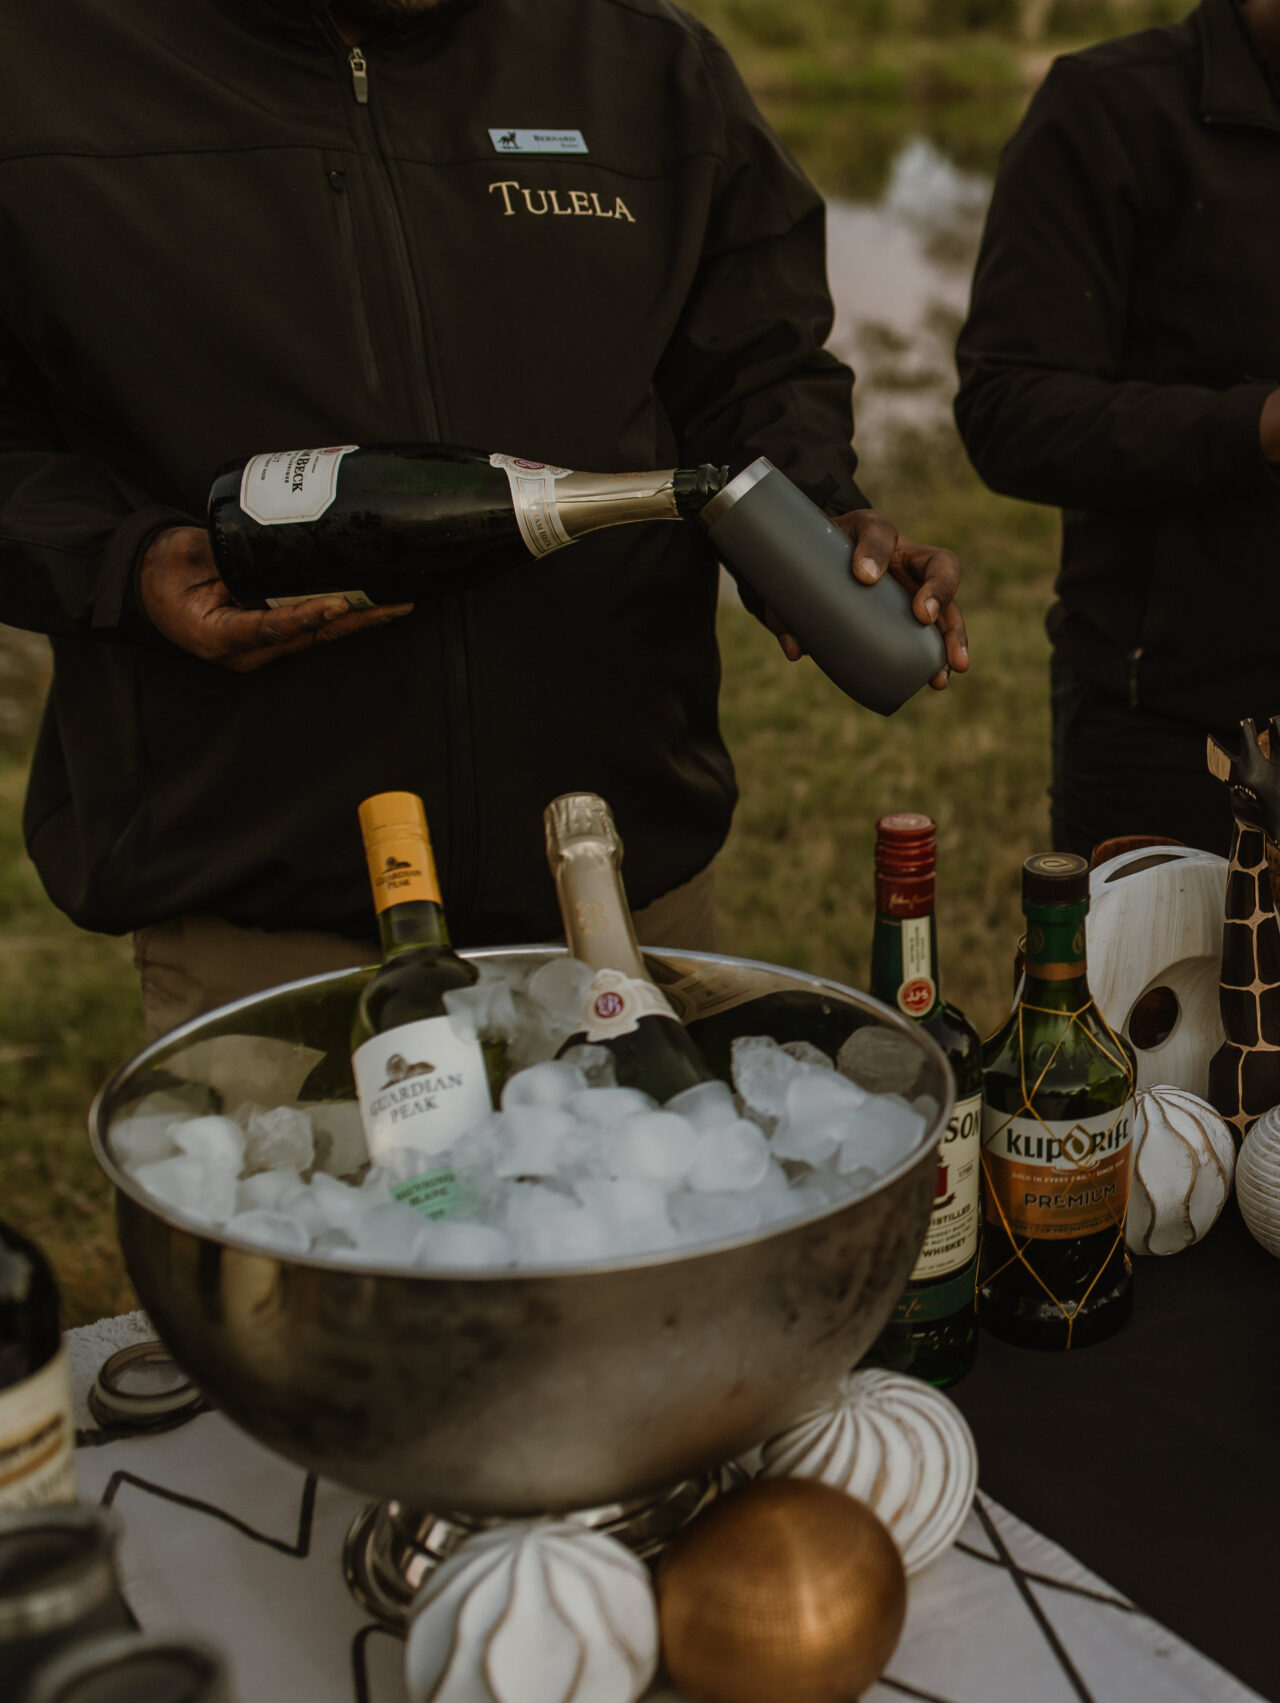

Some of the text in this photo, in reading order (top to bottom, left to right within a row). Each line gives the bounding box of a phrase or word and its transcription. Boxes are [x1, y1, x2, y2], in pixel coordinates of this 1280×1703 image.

[488, 181, 636, 223] TULELA
[370, 1073, 464, 1116] GUARDIAN
[391, 1095, 439, 1124] PEAK
[944, 1110, 979, 1144] SON
[1024, 1183, 1117, 1209] PREMIUM
[929, 1204, 971, 1226] ISTILLED
